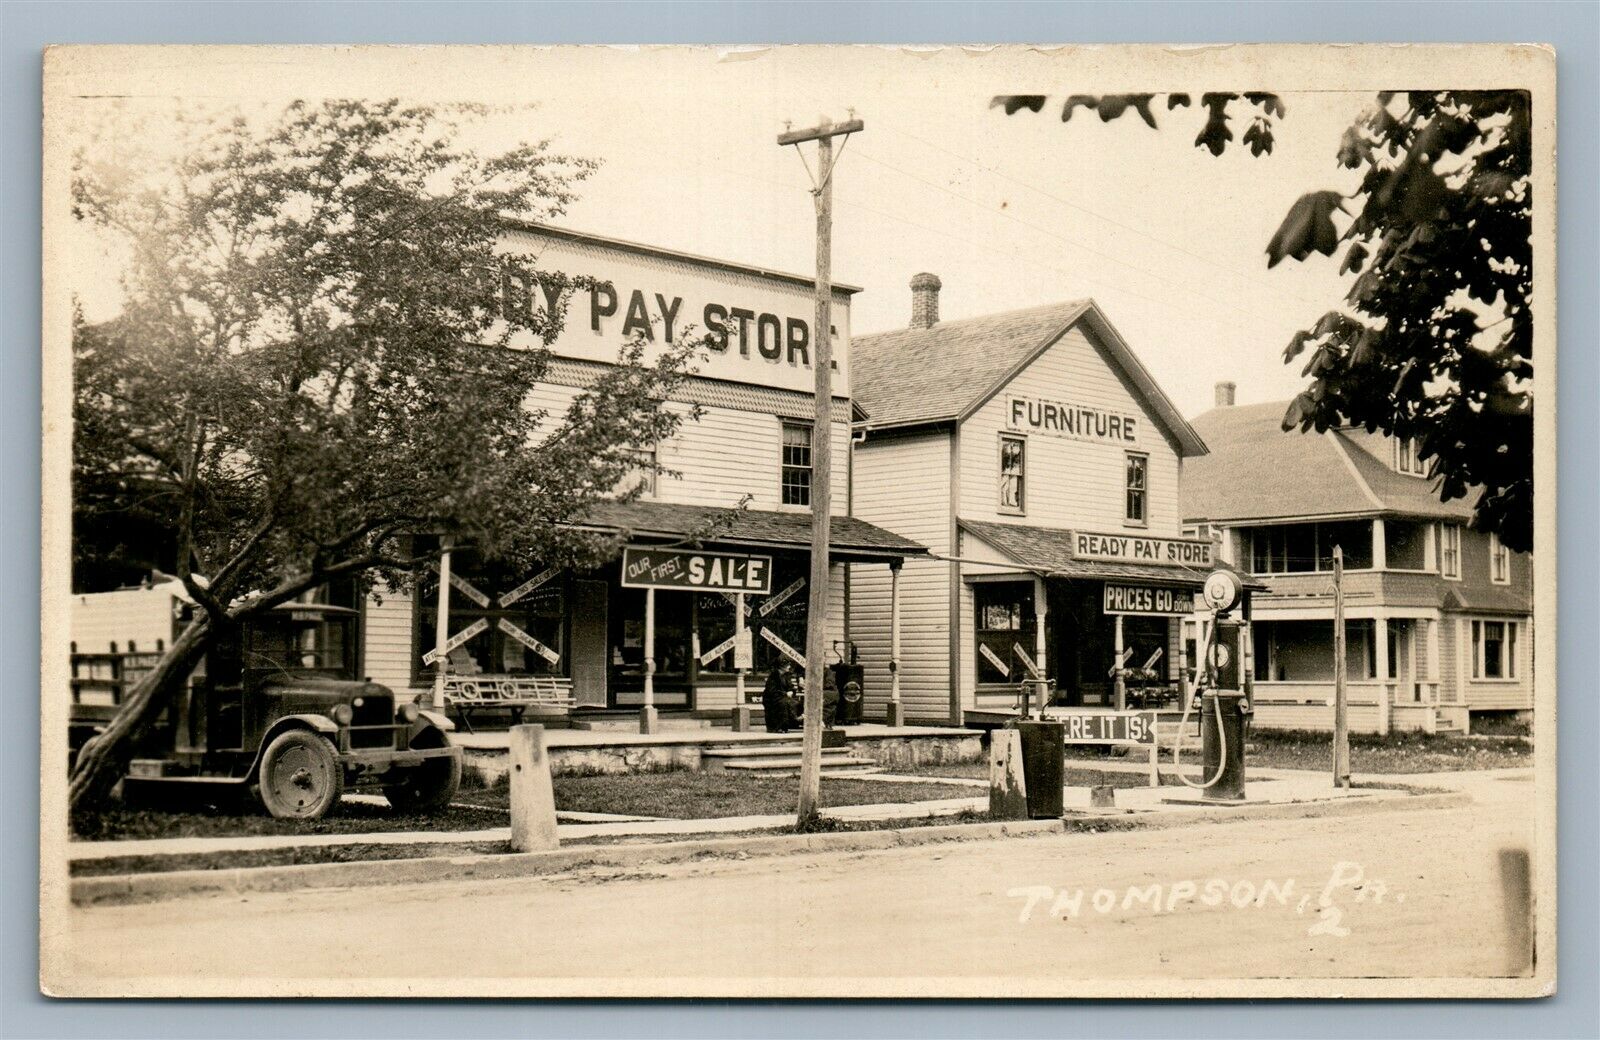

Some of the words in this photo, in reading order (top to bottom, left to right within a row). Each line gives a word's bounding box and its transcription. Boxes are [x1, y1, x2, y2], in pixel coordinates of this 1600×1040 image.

[590, 281, 683, 344] PAY
[703, 303, 838, 370] STOR
[1012, 399, 1137, 442] FURNITURE
[1078, 534, 1128, 557] READY
[1134, 539, 1161, 559] PAY
[1167, 542, 1210, 563] STORE
[628, 557, 651, 578] OUR
[650, 556, 681, 582] FIRST
[688, 557, 763, 588] SALE
[1106, 586, 1153, 611] PRICES
[1156, 590, 1173, 612] GO
[1100, 716, 1117, 739] IT
[1125, 716, 1148, 740] IS!
